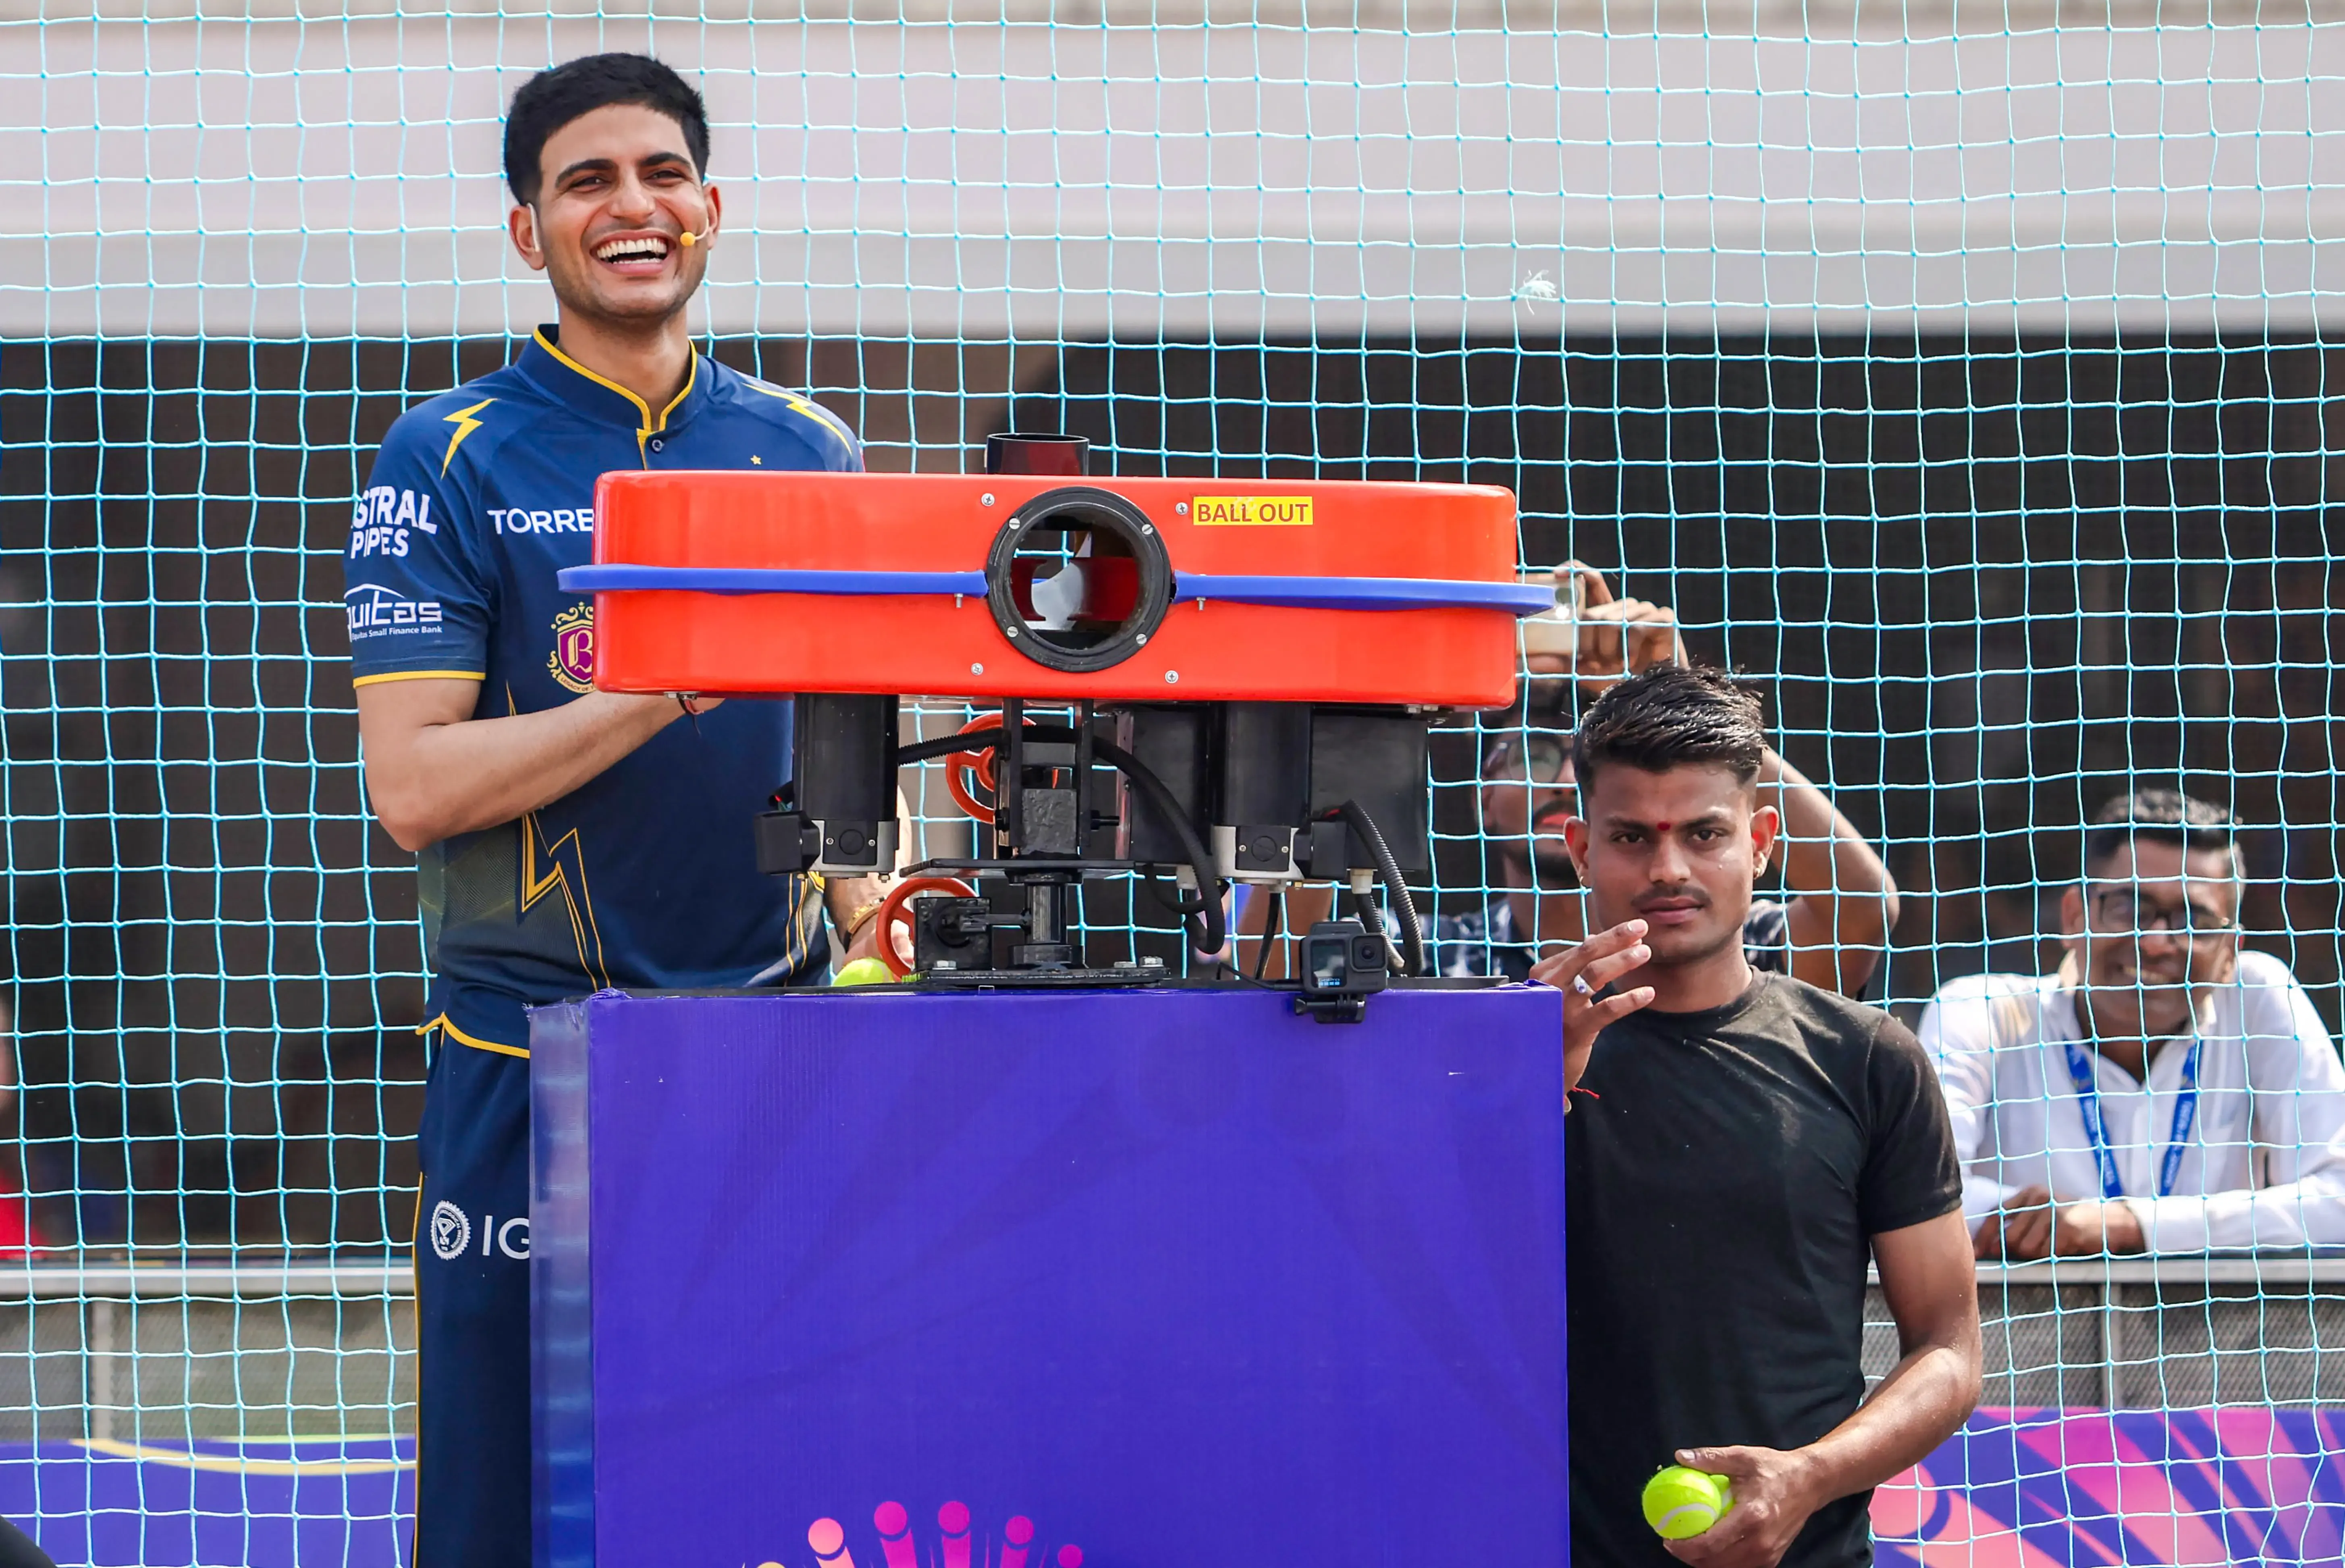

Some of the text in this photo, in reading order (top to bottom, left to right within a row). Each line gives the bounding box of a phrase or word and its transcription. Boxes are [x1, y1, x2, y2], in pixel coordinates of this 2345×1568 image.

[351, 486, 437, 534] STRAL
[487, 508, 594, 534] TORRE
[1198, 504, 1309, 522] BALL OUT
[351, 527, 409, 559] PIPES
[369, 628, 387, 637] Small
[422, 626, 442, 634] Bank
[482, 1215, 530, 1260] IG
